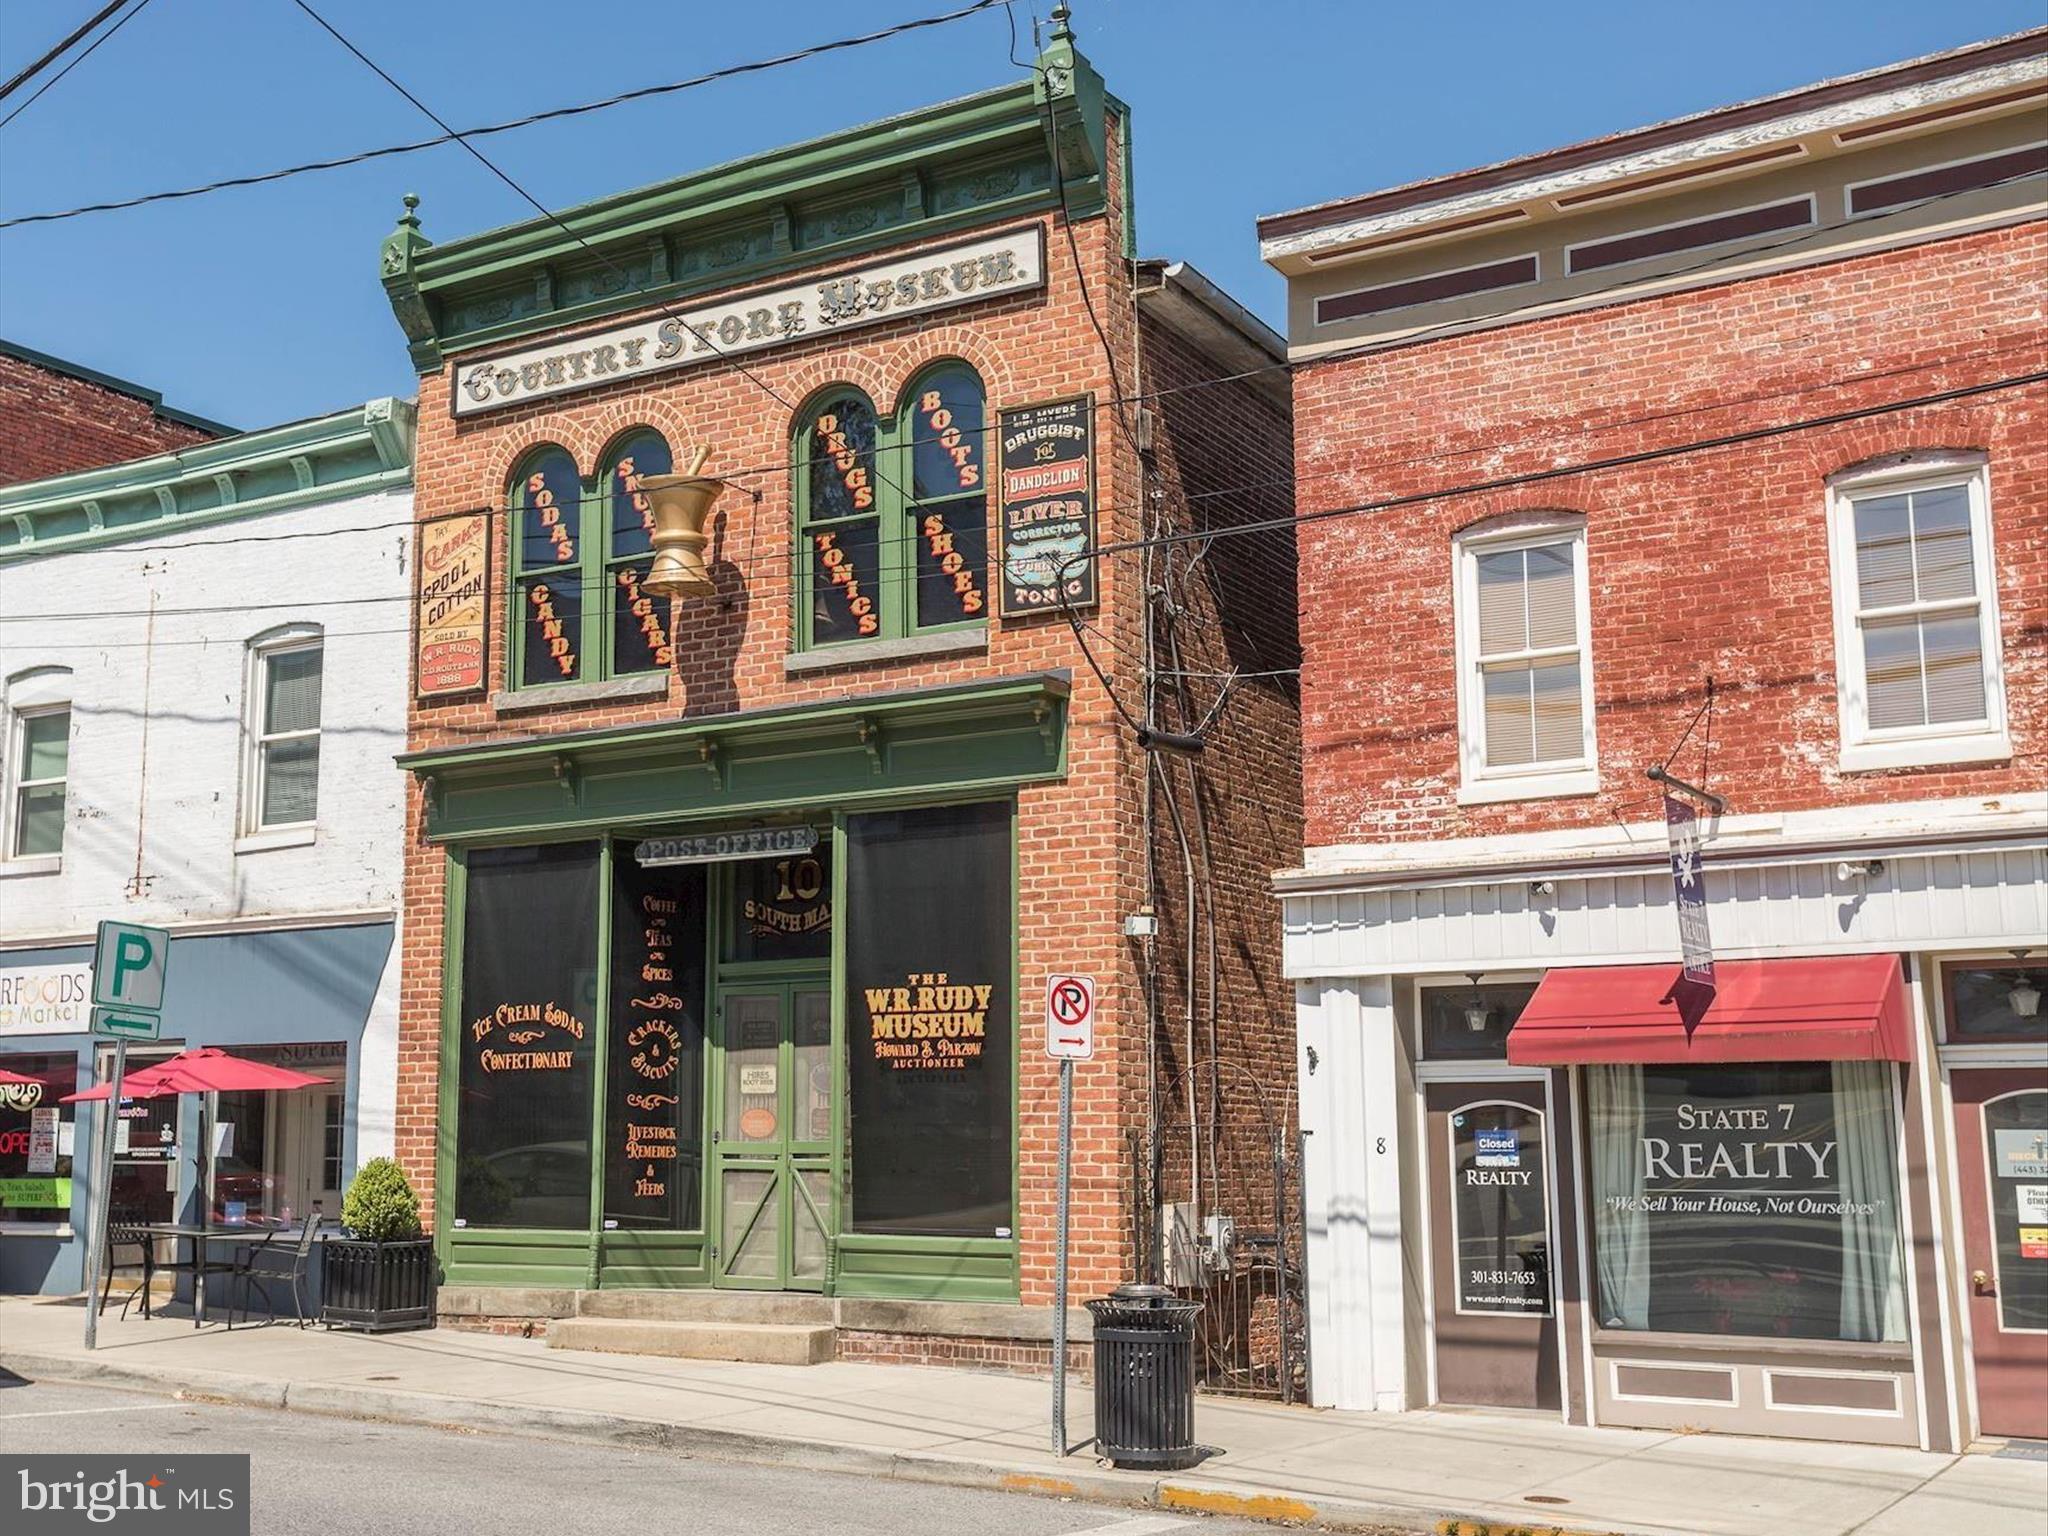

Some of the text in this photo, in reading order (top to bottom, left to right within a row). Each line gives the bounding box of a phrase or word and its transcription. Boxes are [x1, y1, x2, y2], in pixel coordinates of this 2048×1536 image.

[463, 337, 647, 401] COUNTRY
[655, 300, 806, 359] STORE
[920, 391, 980, 487] BOOTS
[1004, 423, 1085, 453] DRUGGIST
[816, 414, 873, 509] DRUGS
[1010, 467, 1079, 494] DANDELION
[528, 472, 574, 562] SODAS
[1007, 500, 1087, 529] LIVER
[1012, 522, 1082, 540] CORRECTOR
[924, 514, 983, 614] SHOES
[423, 559, 470, 604] SPOOL
[815, 532, 878, 635] TONICS
[428, 573, 483, 626] COTTON
[530, 584, 576, 675] CANDY
[617, 567, 672, 666] CIGARS
[434, 629, 469, 642] SOLD BY
[449, 643, 480, 657] RUDY
[648, 828, 806, 858] POST-OFFICE
[776, 858, 823, 900] 10
[744, 900, 832, 932] SOUTH MA
[112, 932, 153, 998] P
[641, 963, 674, 982] SPICES
[908, 973, 948, 985] THE
[19, 1006, 79, 1025] Market
[471, 1000, 584, 1043] ICE CREAM SODAS
[871, 1012, 986, 1039] MUSEUM
[628, 1018, 683, 1050] CRACKERS
[480, 1048, 574, 1073] CONFECTIONARY
[651, 1043, 660, 1057] &
[874, 1041, 919, 1059] HOWARD
[937, 1039, 983, 1058] PARZOW
[630, 1051, 680, 1080] BISCUITS
[892, 1058, 965, 1069] AUCTIONEER
[1677, 1103, 1796, 1131] STATE 7
[0, 1133, 31, 1155] OPE
[627, 1123, 677, 1142] LIVESTOCK
[1376, 1137, 1386, 1154] 8
[1479, 1138, 1515, 1149] Closed
[626, 1141, 677, 1160] REMEDIES
[1642, 1137, 1840, 1180] REALTY
[646, 1164, 655, 1177] &
[1465, 1169, 1532, 1186] REALTY
[634, 1179, 665, 1197] FEEDS
[1639, 1196, 1668, 1212] Sell
[1669, 1197, 1706, 1213] Your
[1707, 1197, 1762, 1216] House,
[1764, 1198, 1795, 1214] Not
[1471, 1270, 1536, 1285] 301-831-7653
[1465, 1295, 1544, 1307] www.state7realty.com
